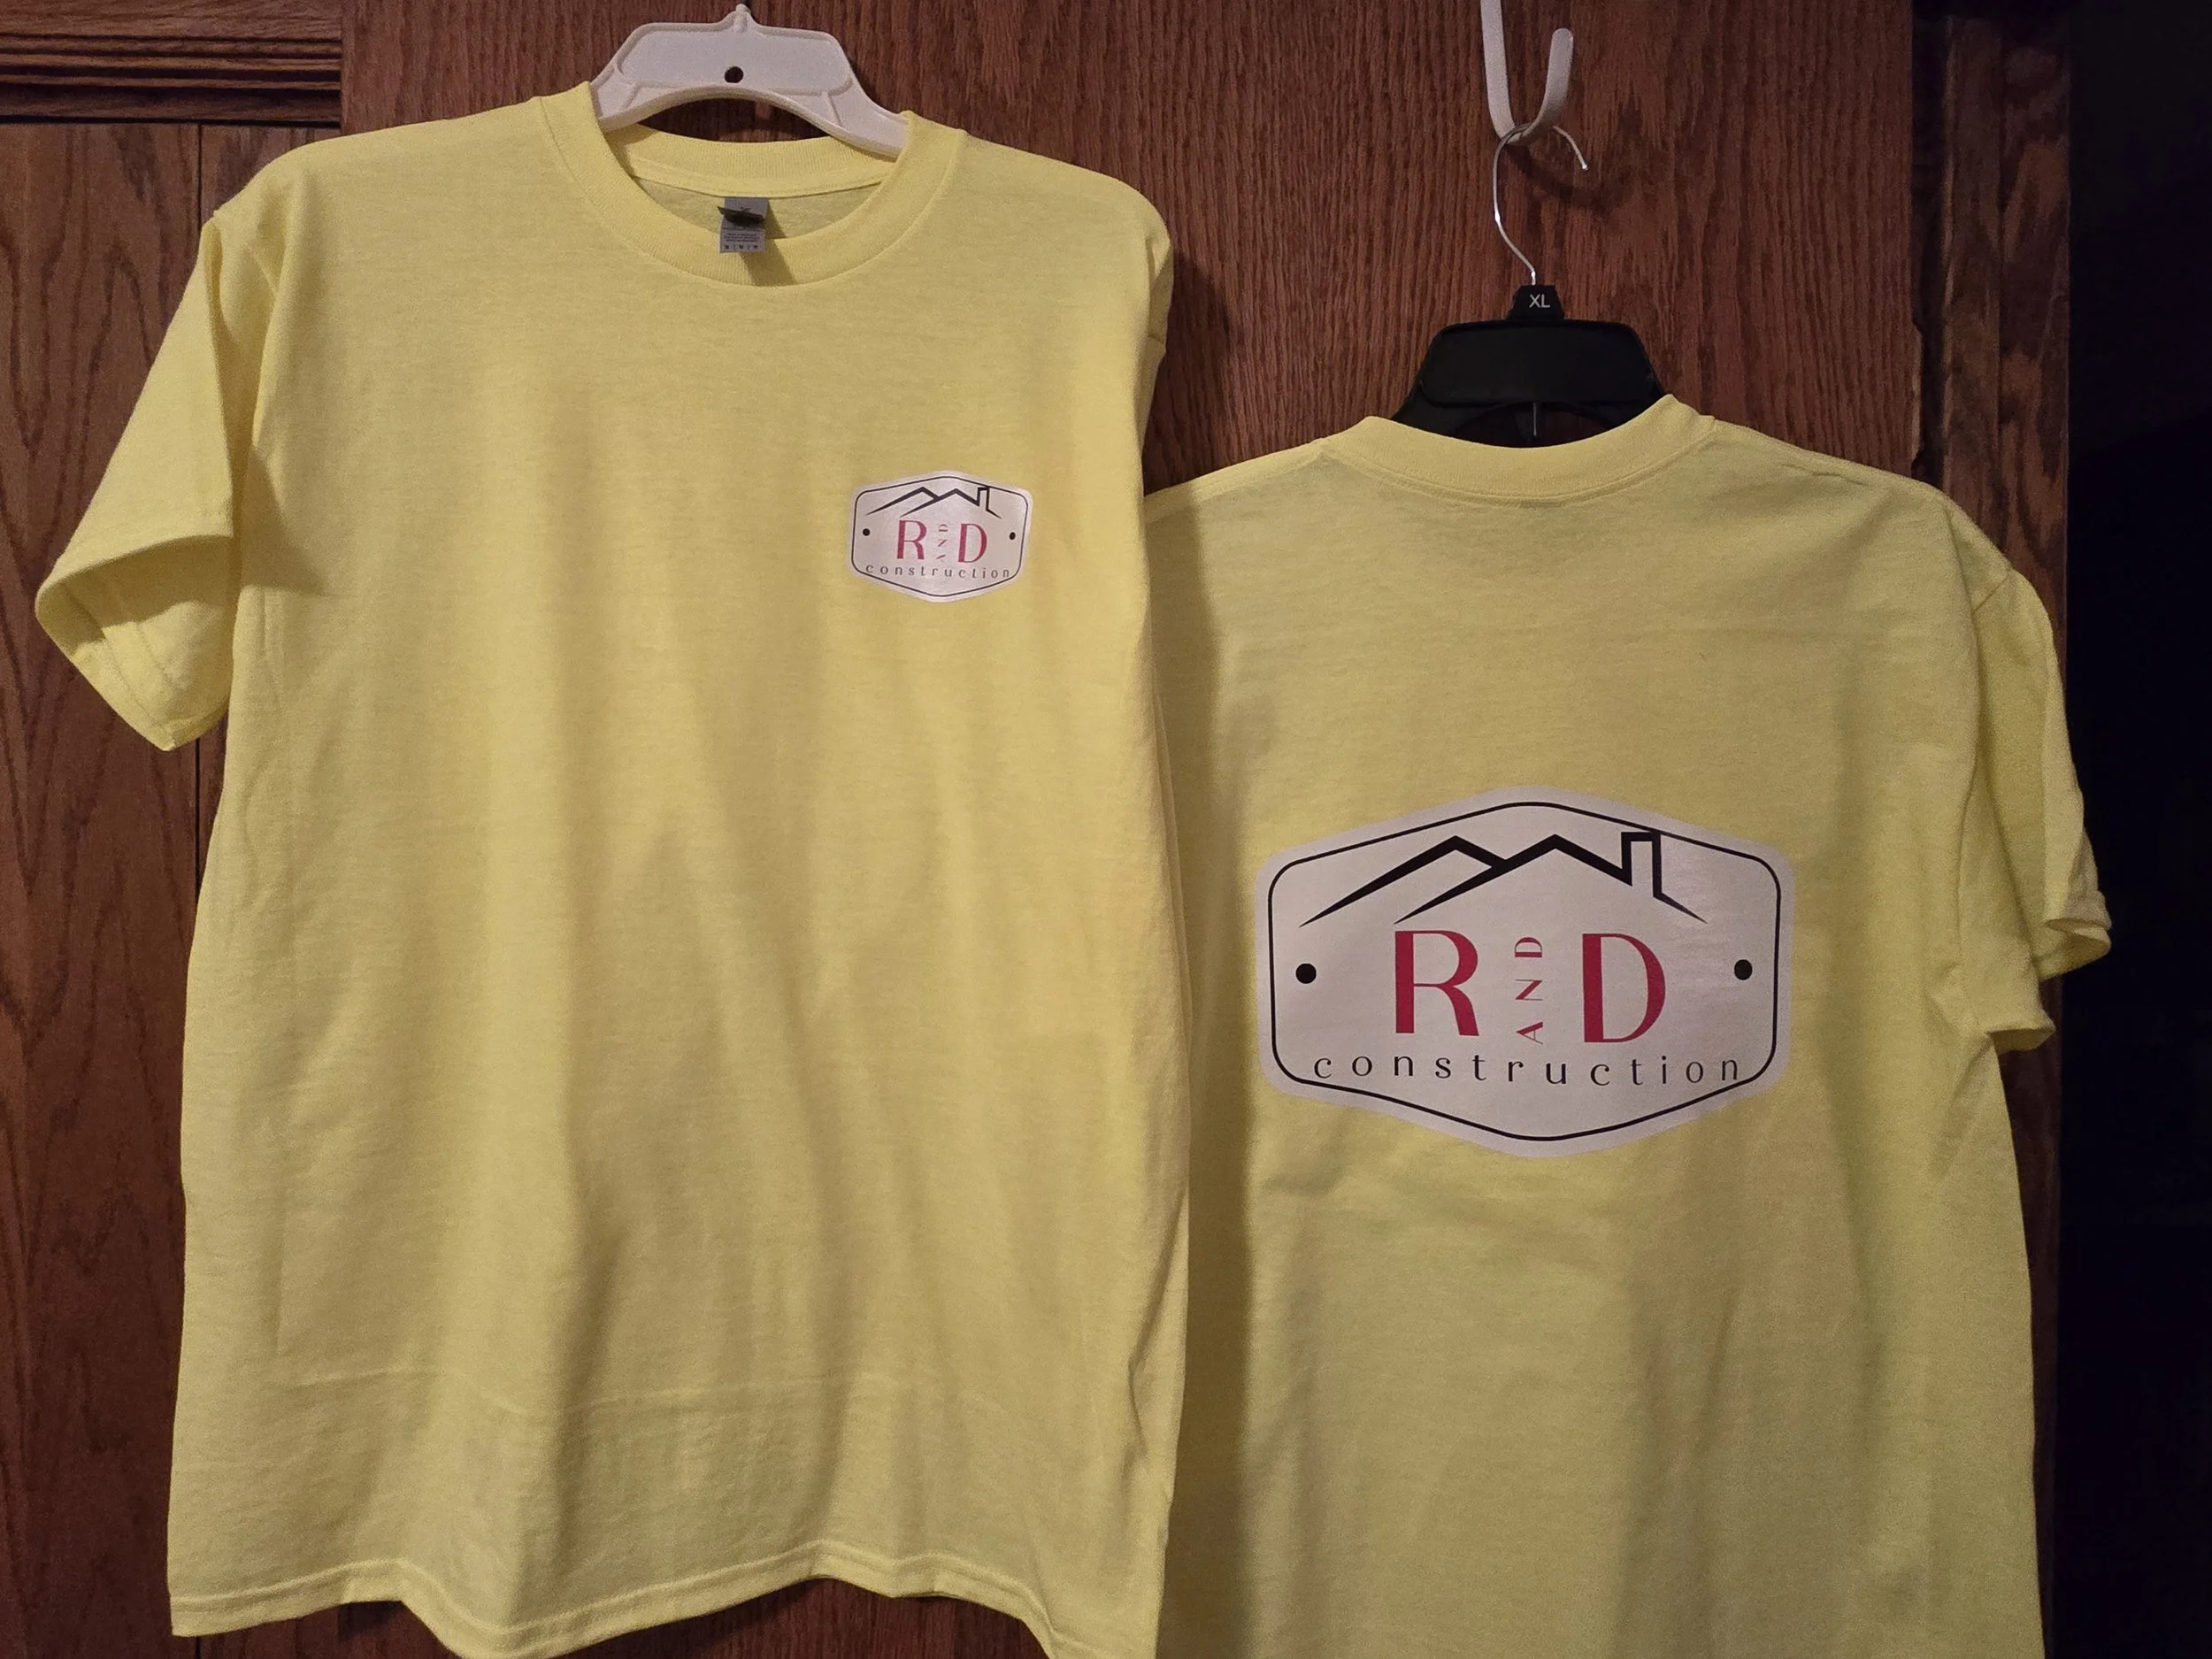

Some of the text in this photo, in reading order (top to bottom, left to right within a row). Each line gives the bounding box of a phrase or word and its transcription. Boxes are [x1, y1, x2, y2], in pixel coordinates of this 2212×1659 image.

[1529, 294, 1550, 308] XL
[896, 519, 927, 559] R
[957, 523, 987, 563] D
[865, 564, 1010, 579] construction
[1394, 930, 1666, 1045] R AND D
[1314, 1055, 1738, 1087] construction
